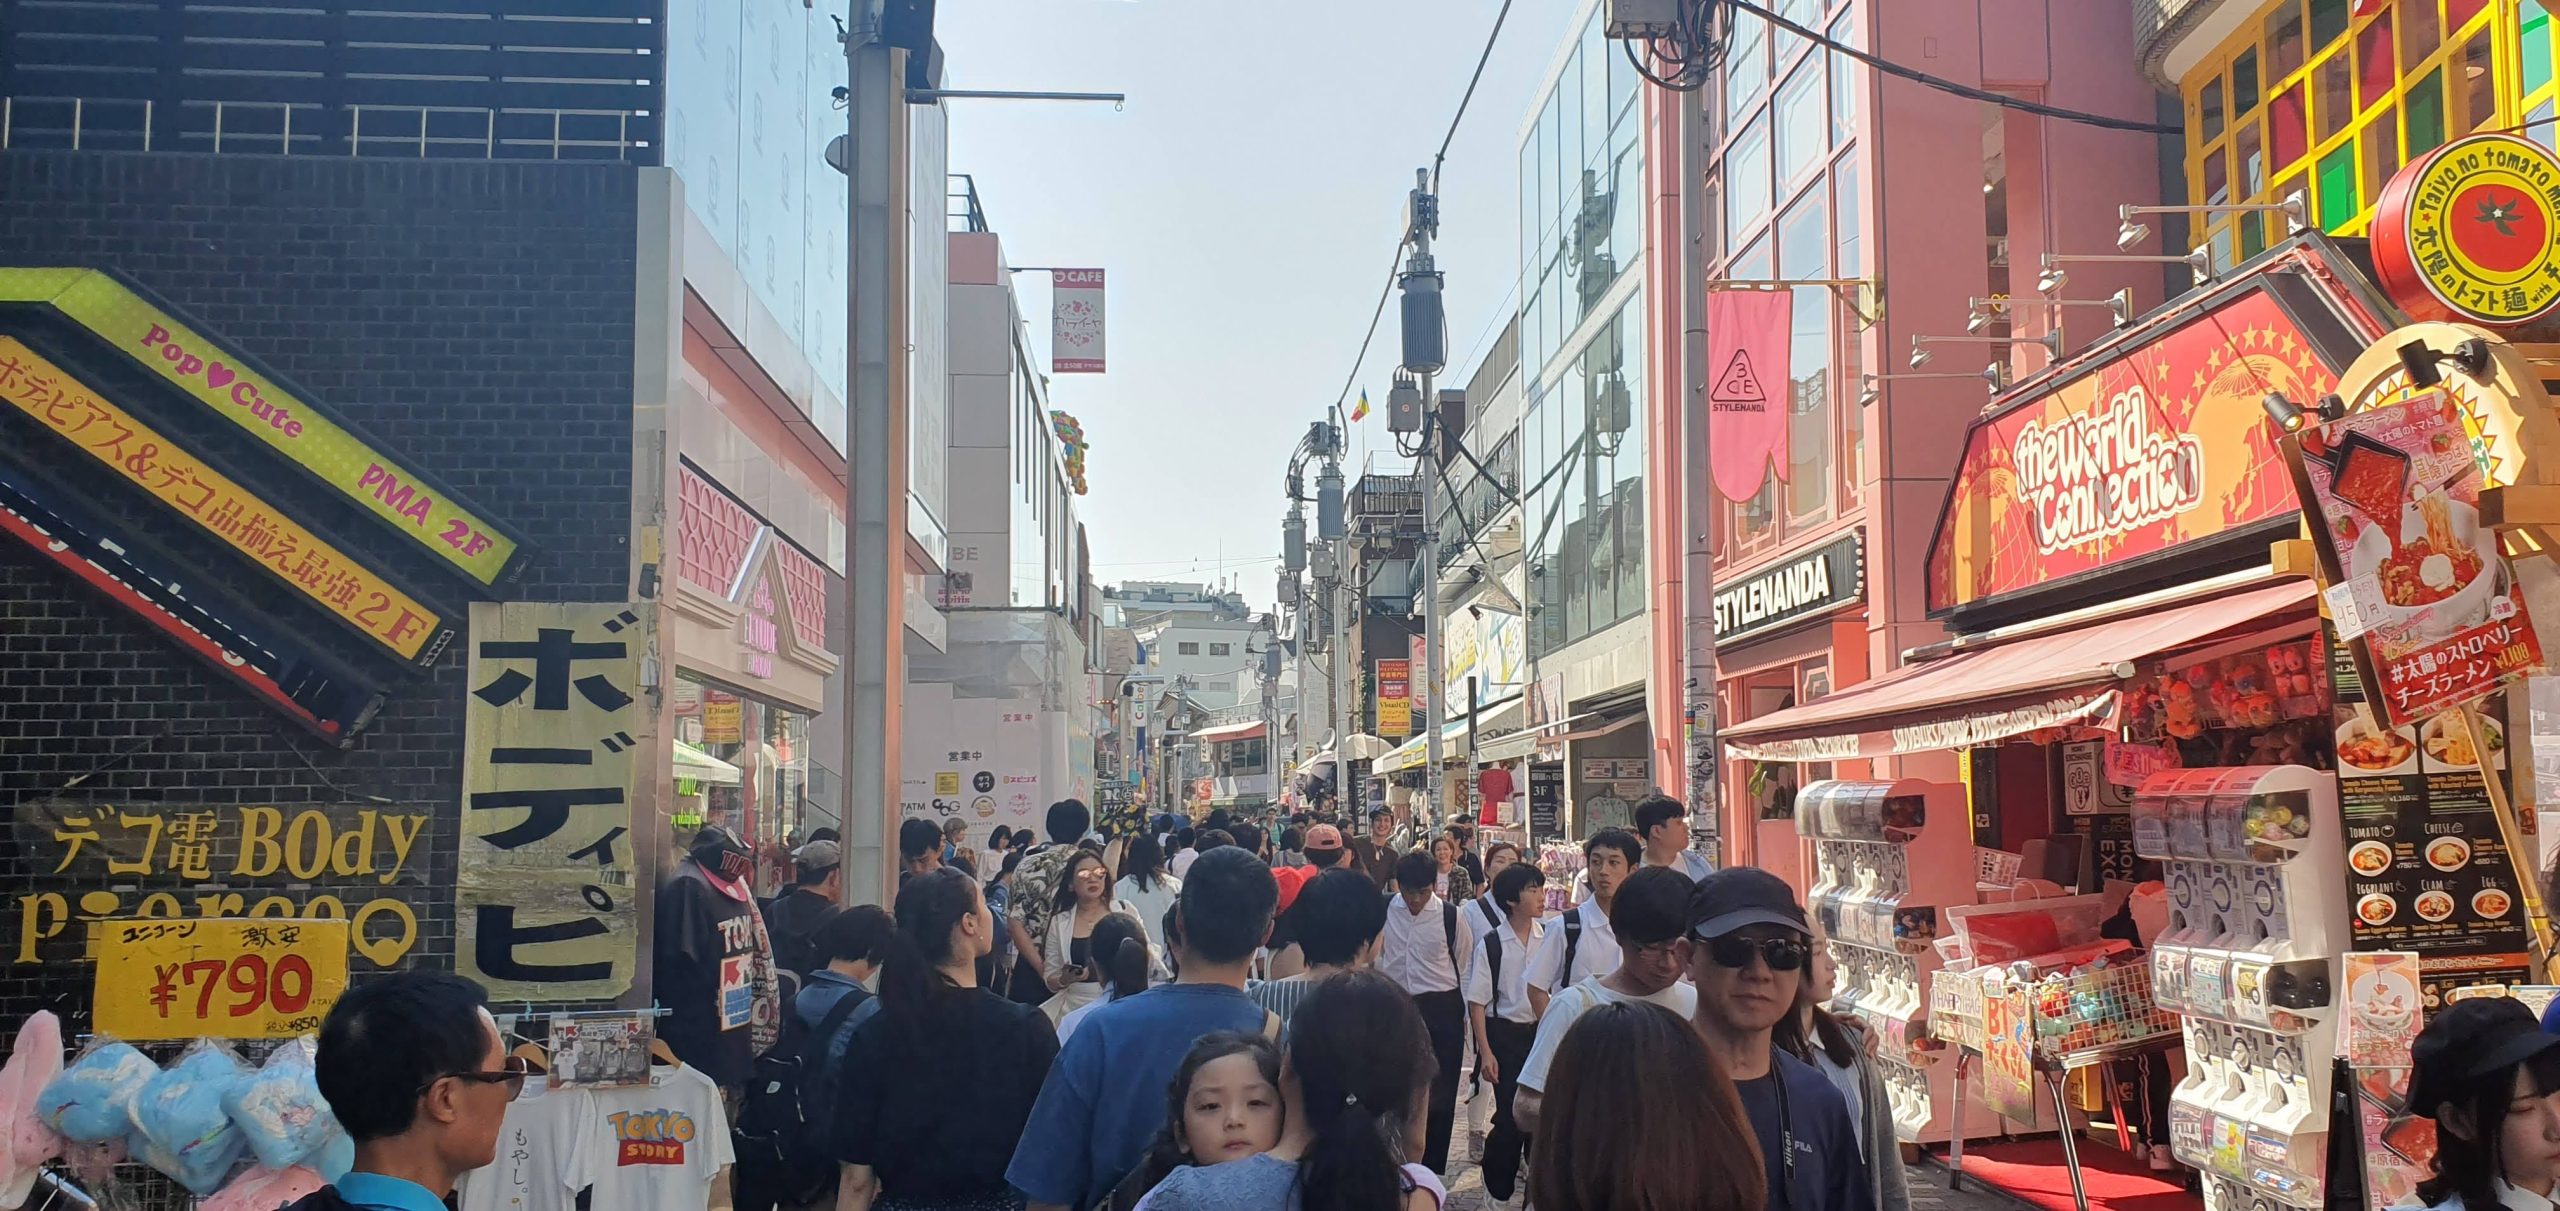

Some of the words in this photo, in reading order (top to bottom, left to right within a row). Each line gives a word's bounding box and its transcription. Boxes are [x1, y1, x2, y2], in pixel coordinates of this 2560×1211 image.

[2419, 167, 2457, 212] Taiyo
[2457, 153, 2479, 174] no
[2484, 147, 2550, 187] tomato
[1067, 271, 1103, 283] CAFE
[2414, 226, 2528, 313] 太陽のトマト麺
[2531, 282, 2553, 304] with
[140, 323, 203, 377] Pop
[230, 380, 304, 439] Cute
[1713, 404, 1766, 413] STYLENANDA
[356, 462, 434, 527] PMA
[438, 519, 494, 561] 2F
[2038, 438, 2199, 547] Connection
[1713, 555, 1830, 638] STYLENANDA
[2391, 626, 2523, 685] #太陽のストロベリー
[2396, 659, 2491, 710] チーズラーメン
[948, 751, 982, 762] 営業中
[471, 609, 640, 985] ボディピ
[1533, 786, 1548, 796] 3F
[53, 804, 219, 881] デコ電
[2349, 827, 2380, 838] TOMATO
[2425, 822, 2450, 835] CHEESE
[2101, 839, 2116, 880] EXC
[2120, 840, 2134, 882] MON
[2356, 882, 2394, 895] EGGPLANT
[2421, 880, 2444, 891] CLAM
[2482, 876, 2497, 887] EGG
[242, 925, 301, 948] 激安
[150, 953, 313, 1019] ¥790
[607, 1107, 695, 1143] TOKYO
[627, 1143, 680, 1159] STORY
[1785, 1131, 1793, 1167] Nikon
[1794, 1140, 1812, 1152] FILA
